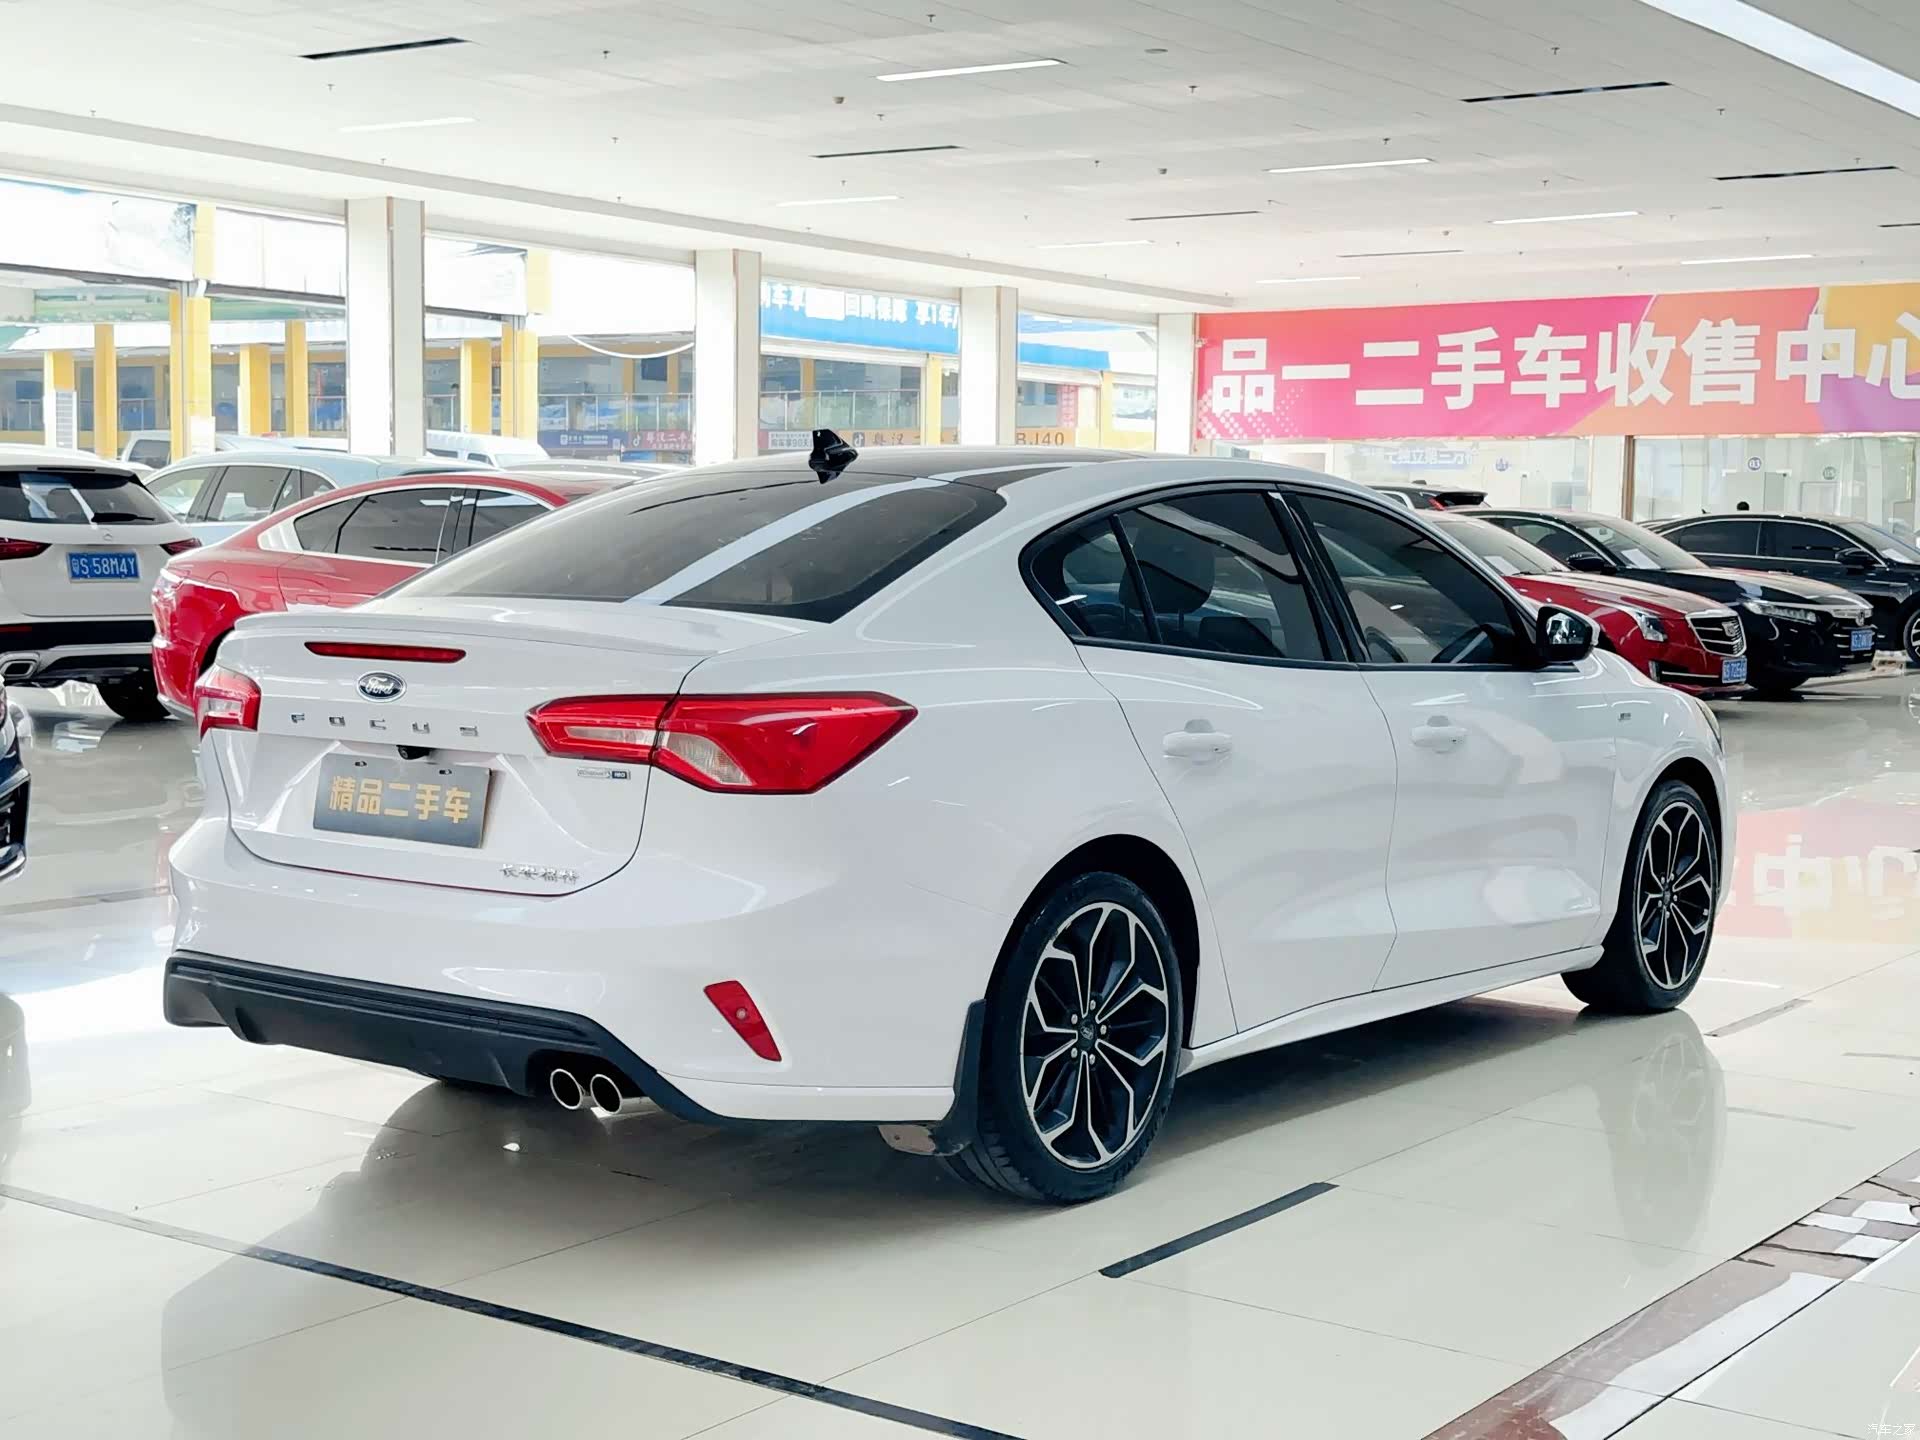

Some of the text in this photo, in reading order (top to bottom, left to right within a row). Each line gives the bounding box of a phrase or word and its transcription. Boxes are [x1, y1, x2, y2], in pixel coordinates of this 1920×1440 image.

[1211, 312, 1920, 413] 品一二手车收售中心
[365, 676, 394, 695] Ford
[291, 713, 479, 737] FOCUS
[329, 775, 471, 824] 精品二手车
